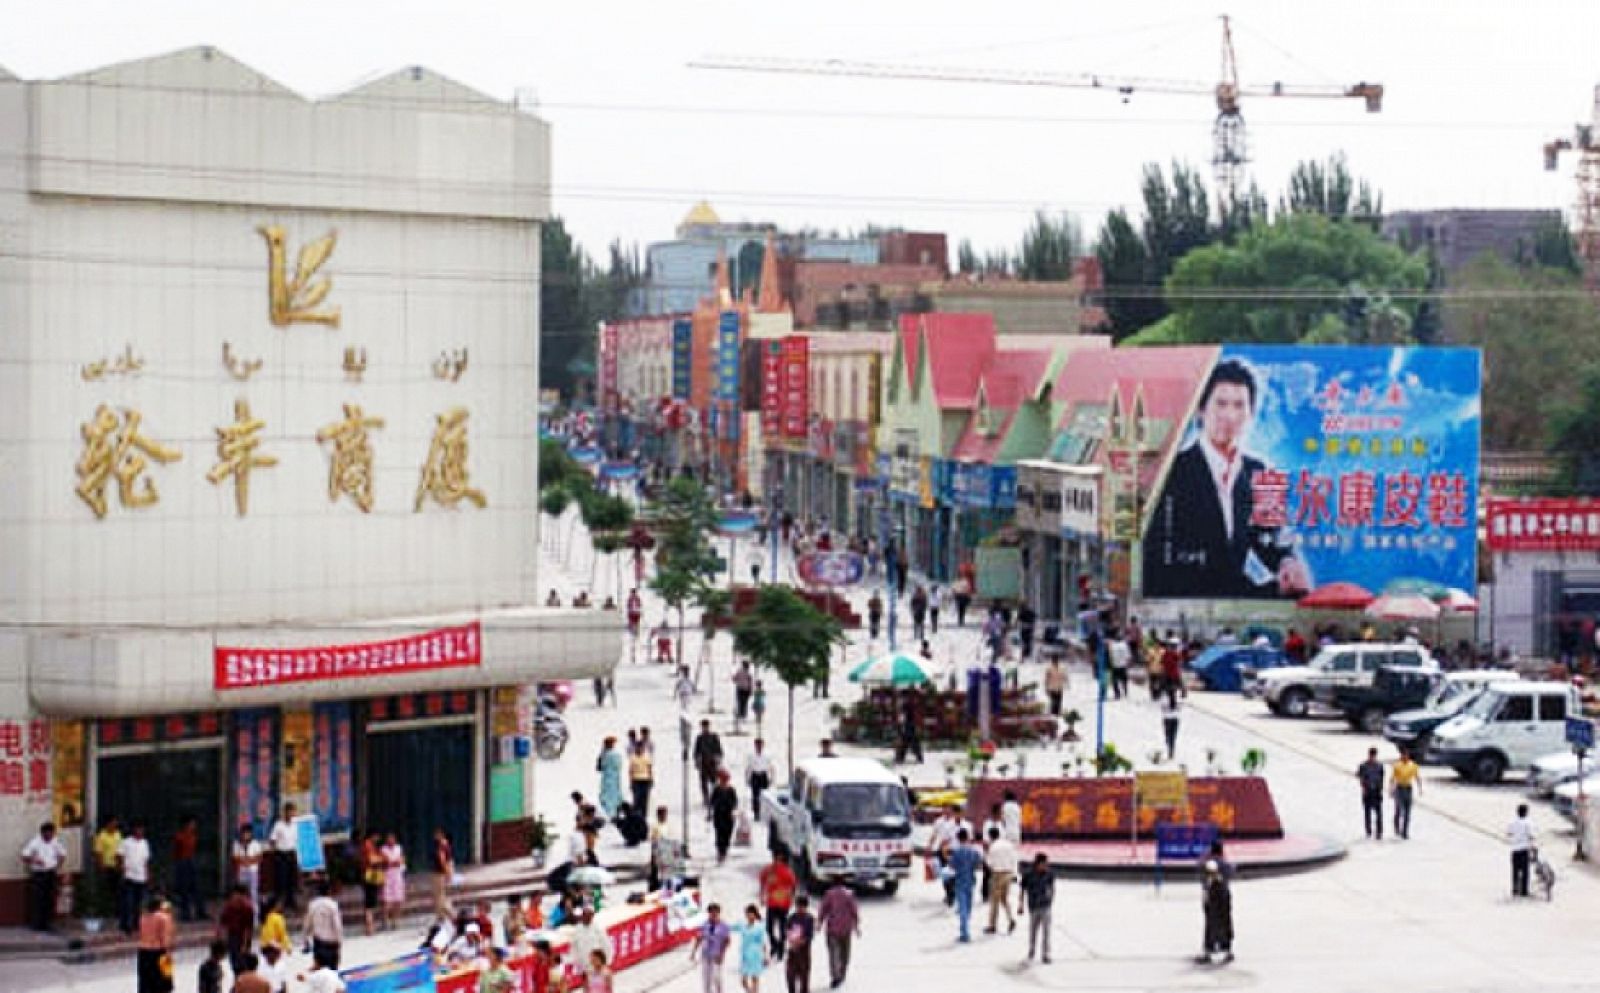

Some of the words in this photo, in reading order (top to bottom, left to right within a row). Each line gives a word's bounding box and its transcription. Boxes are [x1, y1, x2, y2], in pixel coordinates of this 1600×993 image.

[1249, 469, 1467, 527] 意尔康皮鞋
